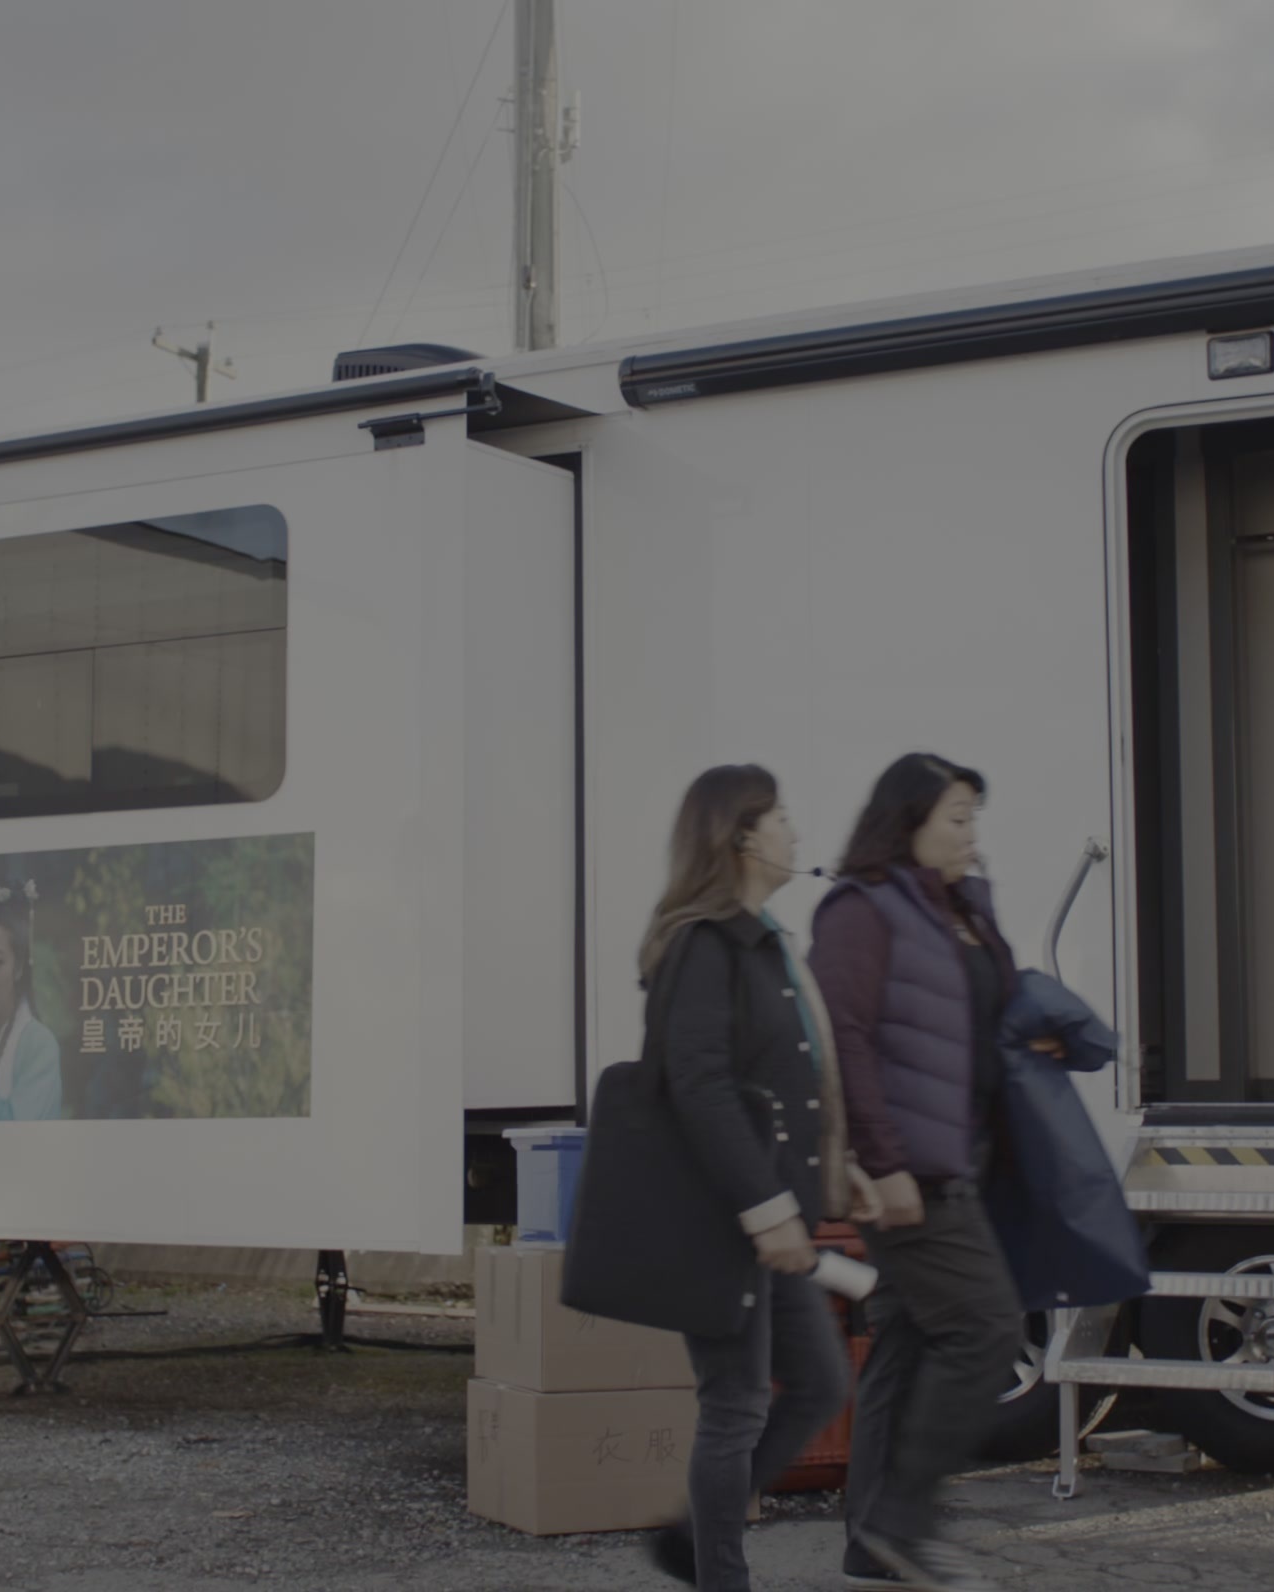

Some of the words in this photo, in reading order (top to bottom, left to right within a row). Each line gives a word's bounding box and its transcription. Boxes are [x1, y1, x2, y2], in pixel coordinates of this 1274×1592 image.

[146, 905, 186, 924] THE
[81, 928, 262, 969] EMPEROR'S
[80, 972, 260, 1010] DAUGHTER
[80, 1014, 260, 1052] 皇帝的女儿
[592, 1427, 686, 1467] 衣服
